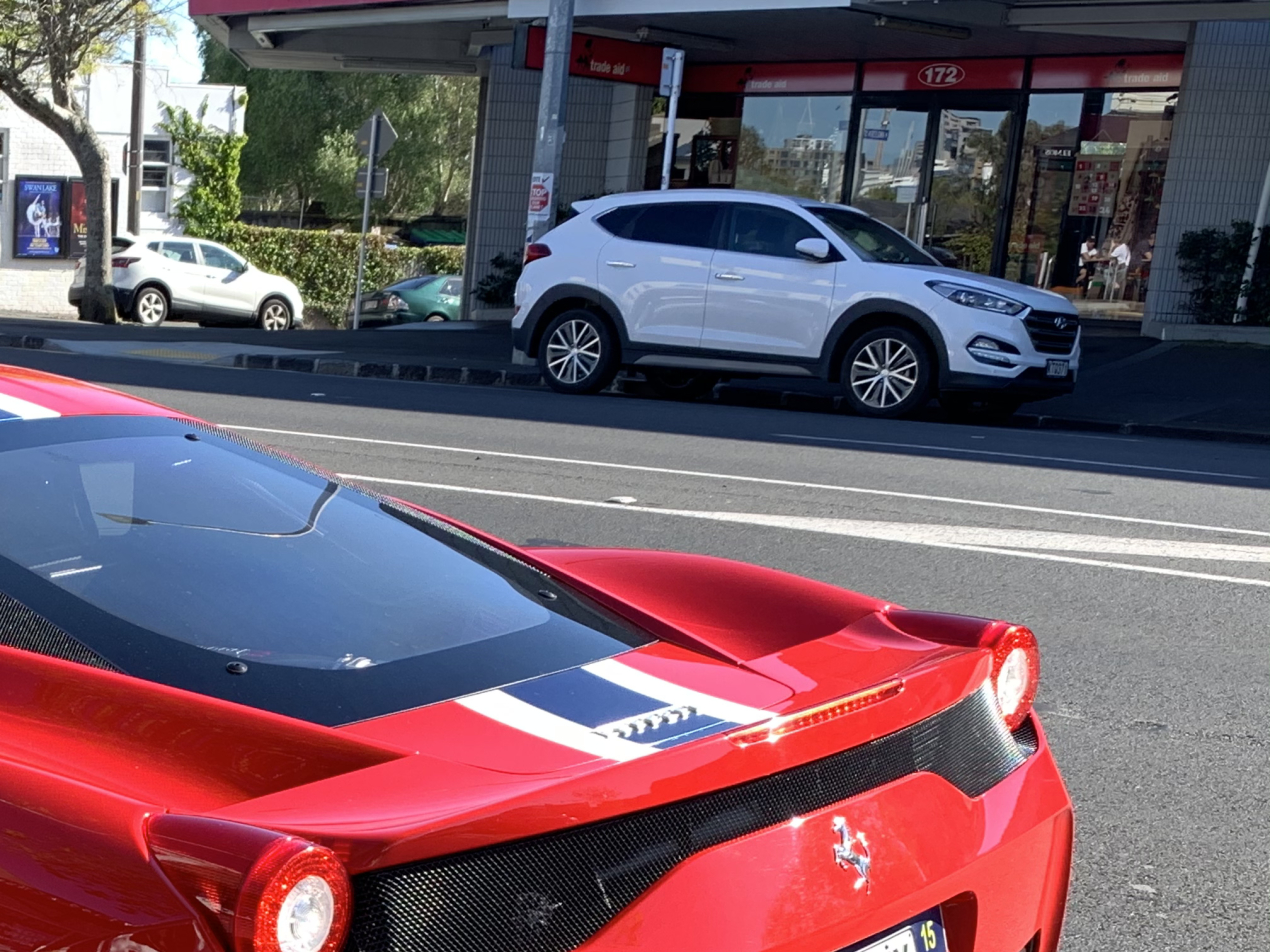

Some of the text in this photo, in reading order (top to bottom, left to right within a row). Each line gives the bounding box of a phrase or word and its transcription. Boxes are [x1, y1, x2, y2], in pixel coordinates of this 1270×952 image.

[590, 59, 625, 76] trade aid
[924, 66, 958, 84] 172
[1123, 72, 1169, 84] trade aid
[750, 79, 787, 89] trade aid
[24, 183, 57, 192] SWAN LAKE
[921, 920, 937, 952] 15
